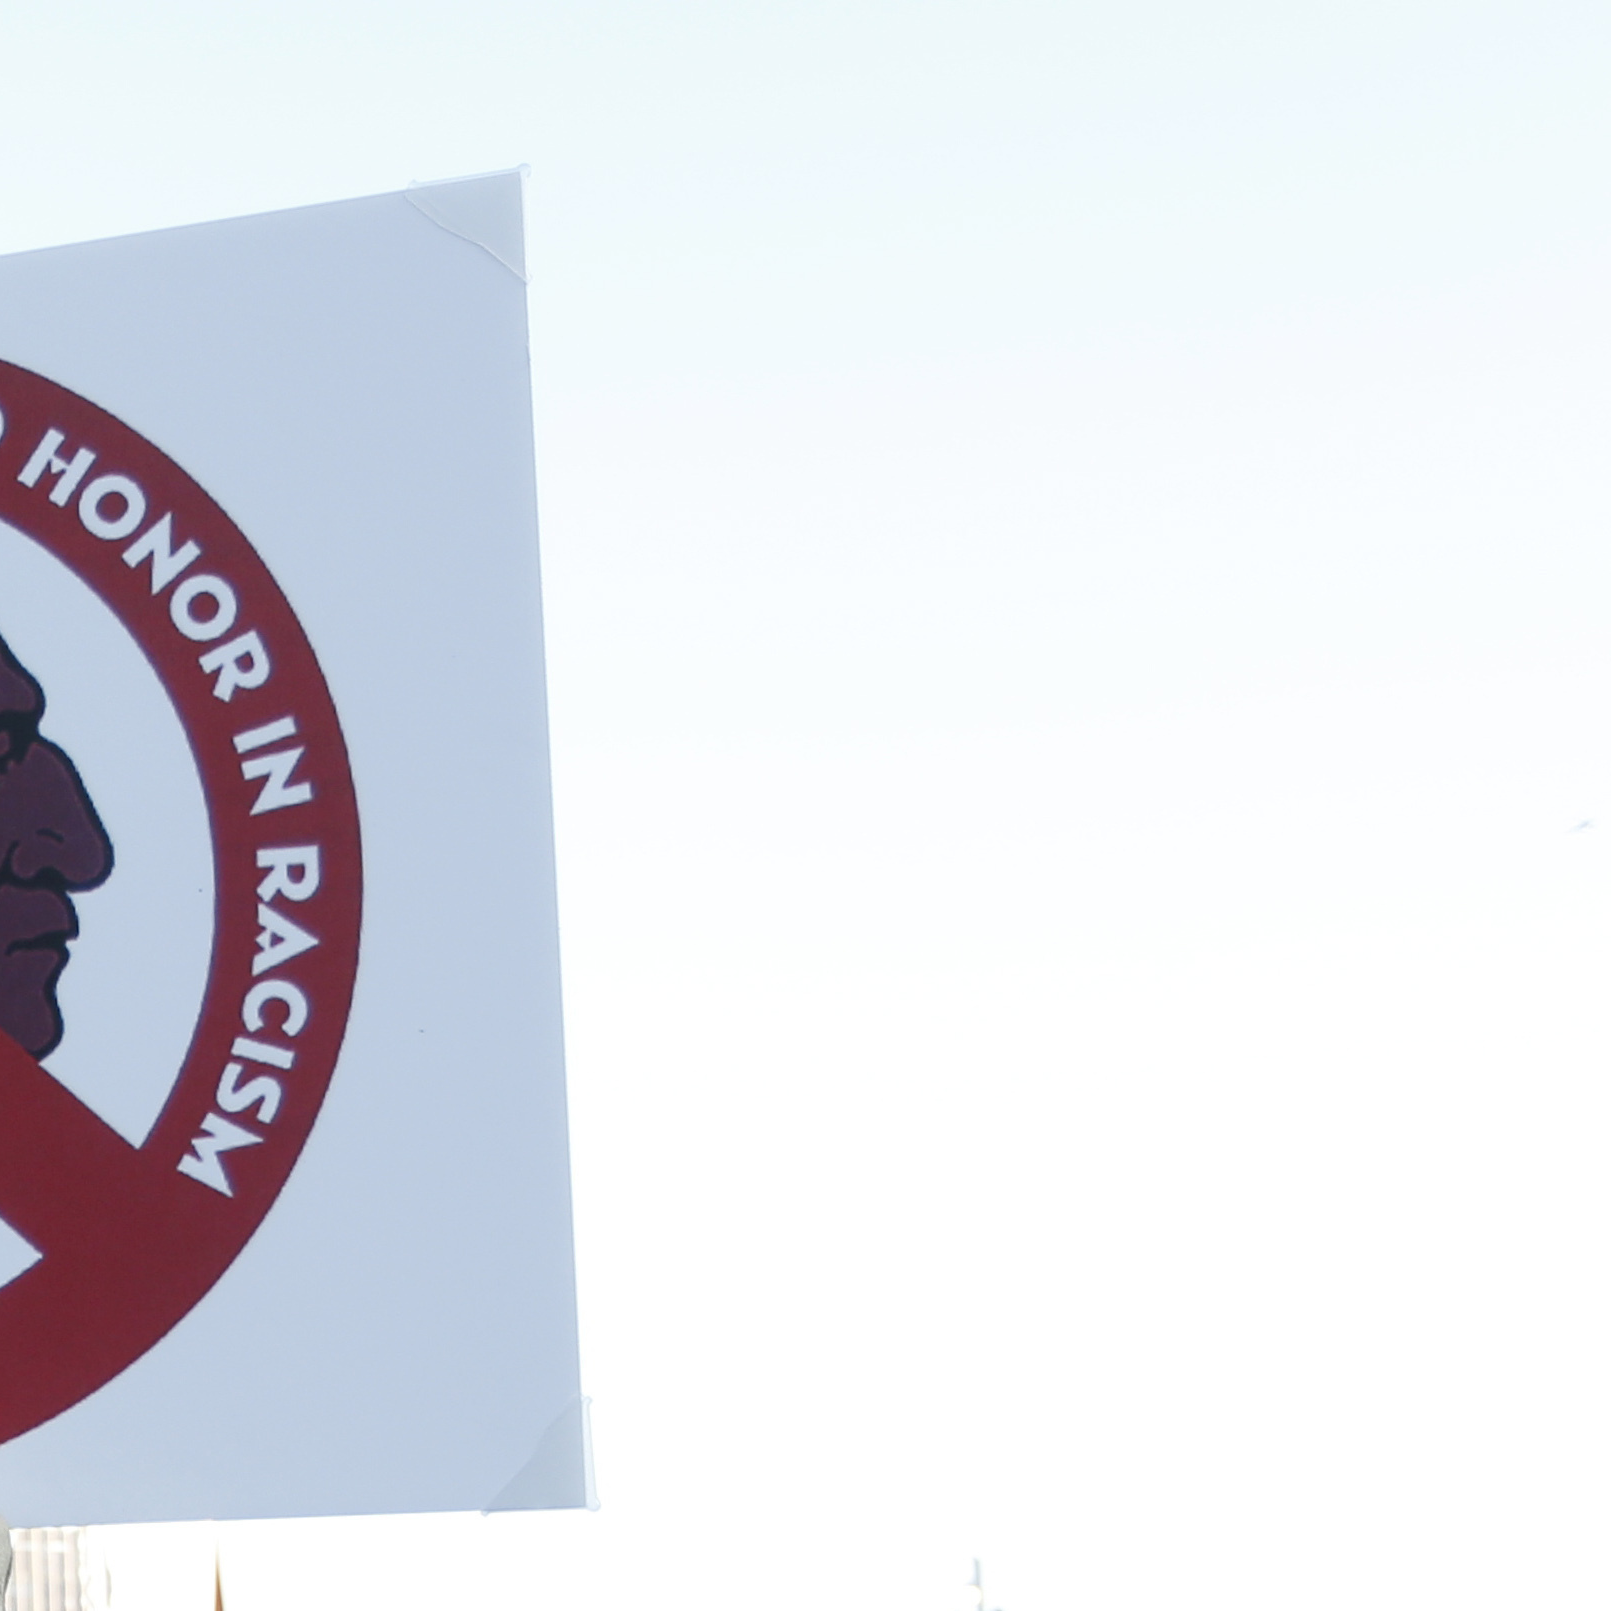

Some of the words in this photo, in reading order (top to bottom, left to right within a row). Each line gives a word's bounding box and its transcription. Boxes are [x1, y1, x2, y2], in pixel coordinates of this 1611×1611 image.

[17, 426, 271, 703] HONOR
[232, 715, 313, 816] IN
[176, 844, 322, 1198] RACISM
